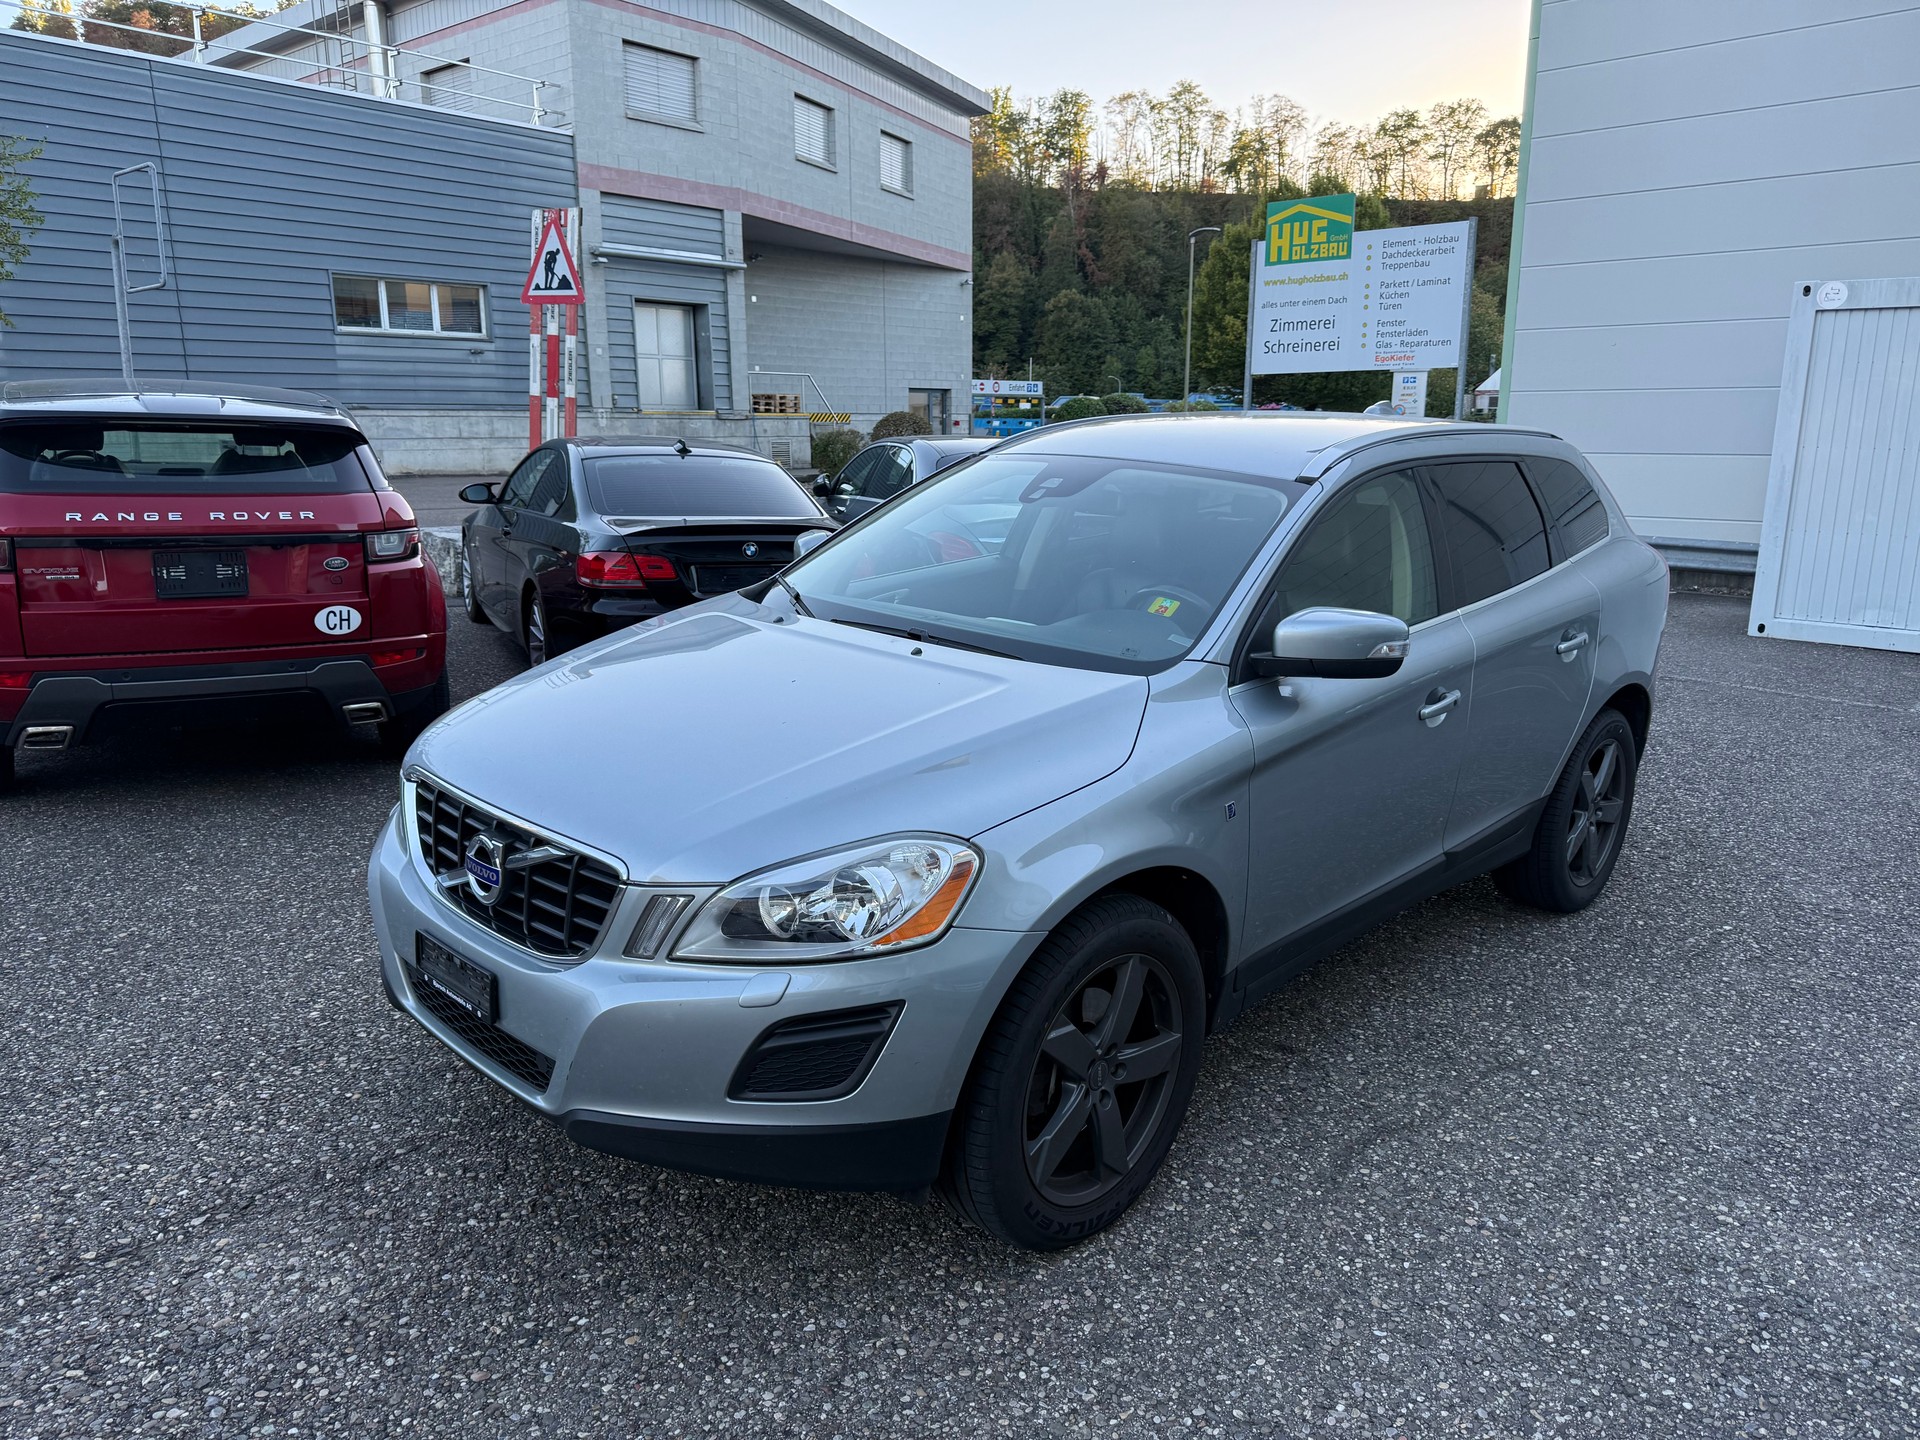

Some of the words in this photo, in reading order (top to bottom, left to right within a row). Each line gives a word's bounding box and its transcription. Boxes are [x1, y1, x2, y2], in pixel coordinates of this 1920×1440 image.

[1270, 219, 1328, 262] HUG
[1383, 238, 1416, 249] Element
[1424, 235, 1460, 245] Holzbau
[1382, 246, 1455, 259] Dachdeckerarbeit
[1382, 260, 1430, 271] Treppenbau
[1264, 272, 1348, 287] www.hugholzbau.ch
[1380, 280, 1410, 289] Parkett
[1416, 277, 1451, 287] Laminat
[1379, 290, 1410, 300] Küchen
[1261, 301, 1278, 309] alles
[1328, 296, 1347, 304] Dach
[1379, 302, 1402, 310] Türen
[1270, 315, 1336, 332] Zimmerei
[1376, 319, 1406, 328] Fenster
[1376, 328, 1428, 338] Fensterläden
[1264, 337, 1340, 354] Schreinerei
[1376, 340, 1392, 349] Glas
[1400, 338, 1452, 349] Reparaturen
[1375, 354, 1415, 363] EgoKiefer
[65, 512, 183, 522] RANGE
[209, 510, 316, 521] ROVER
[325, 610, 351, 630] CH
[466, 859, 497, 881] VOLVO
